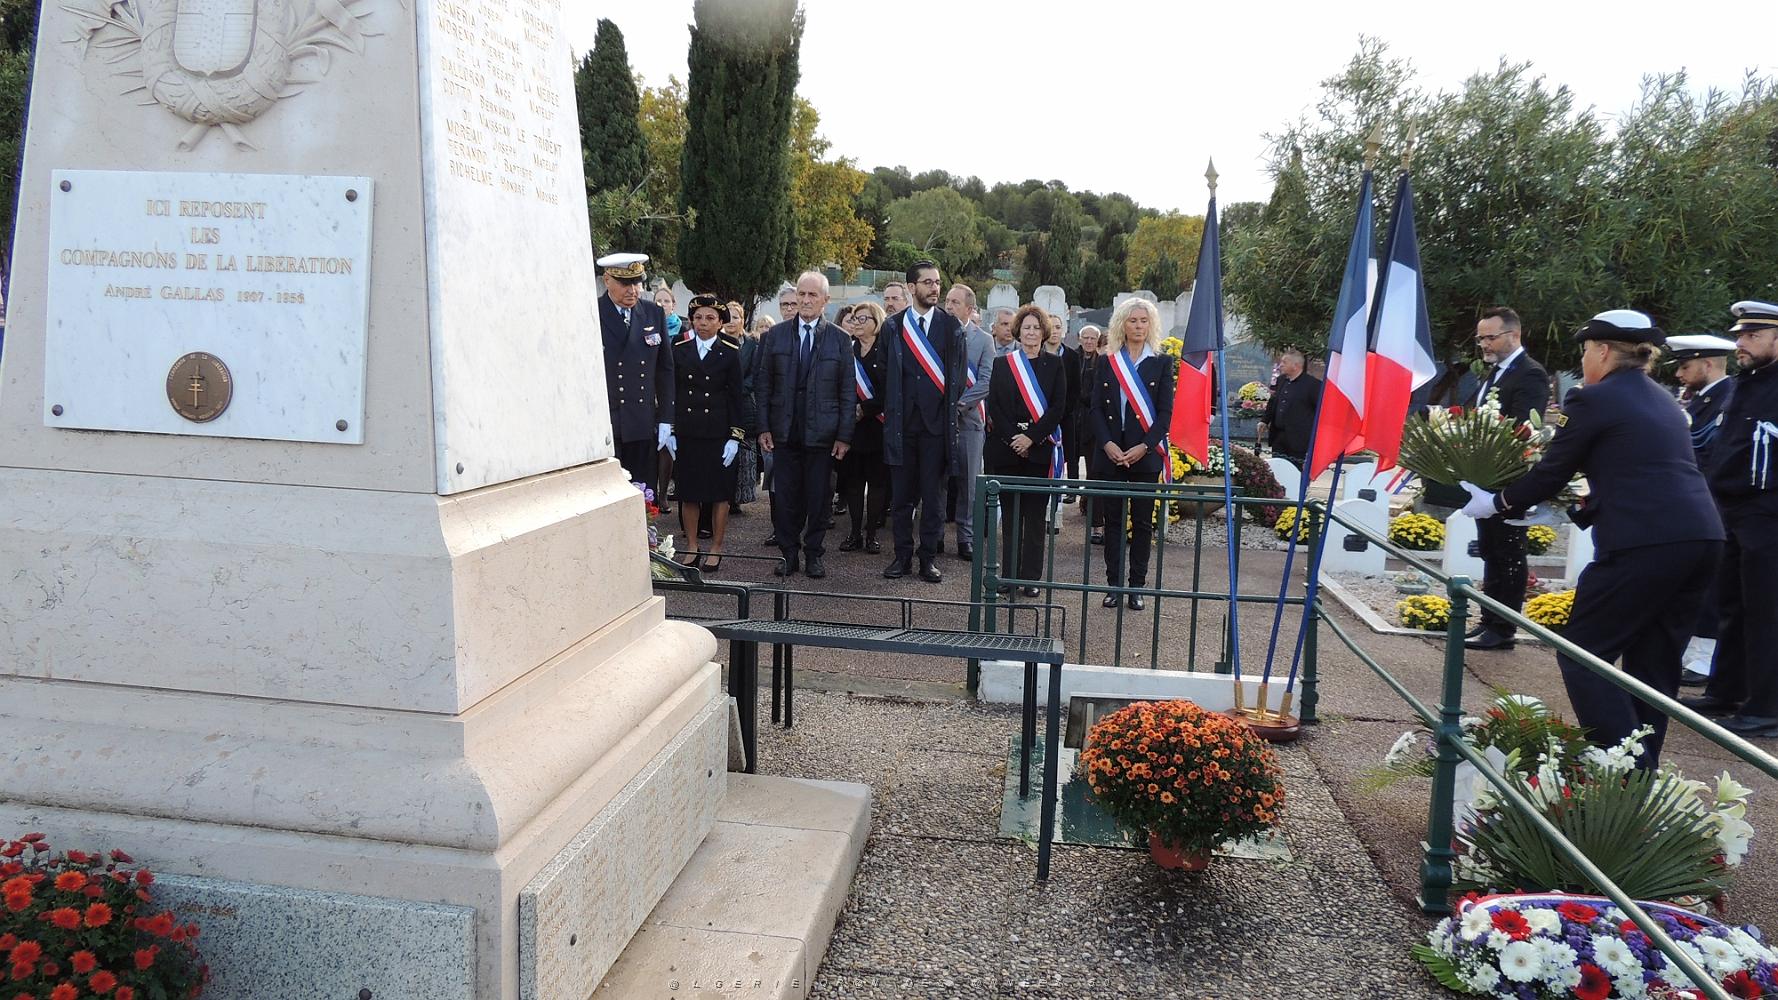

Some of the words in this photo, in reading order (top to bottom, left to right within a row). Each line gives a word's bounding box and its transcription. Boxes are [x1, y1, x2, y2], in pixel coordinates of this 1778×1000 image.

[446, 118, 484, 144] MOREAU
[533, 134, 562, 157] TRIDENT
[449, 159, 494, 187] RICHELME
[146, 199, 171, 217] ICI
[178, 200, 268, 220] REPOSENT
[190, 227, 221, 245] LES
[60, 248, 177, 270] COMPAGNONS
[185, 253, 209, 270] DE
[215, 254, 238, 272] LA
[246, 255, 354, 275] LIBERATION
[159, 285, 225, 303] GALLAS
